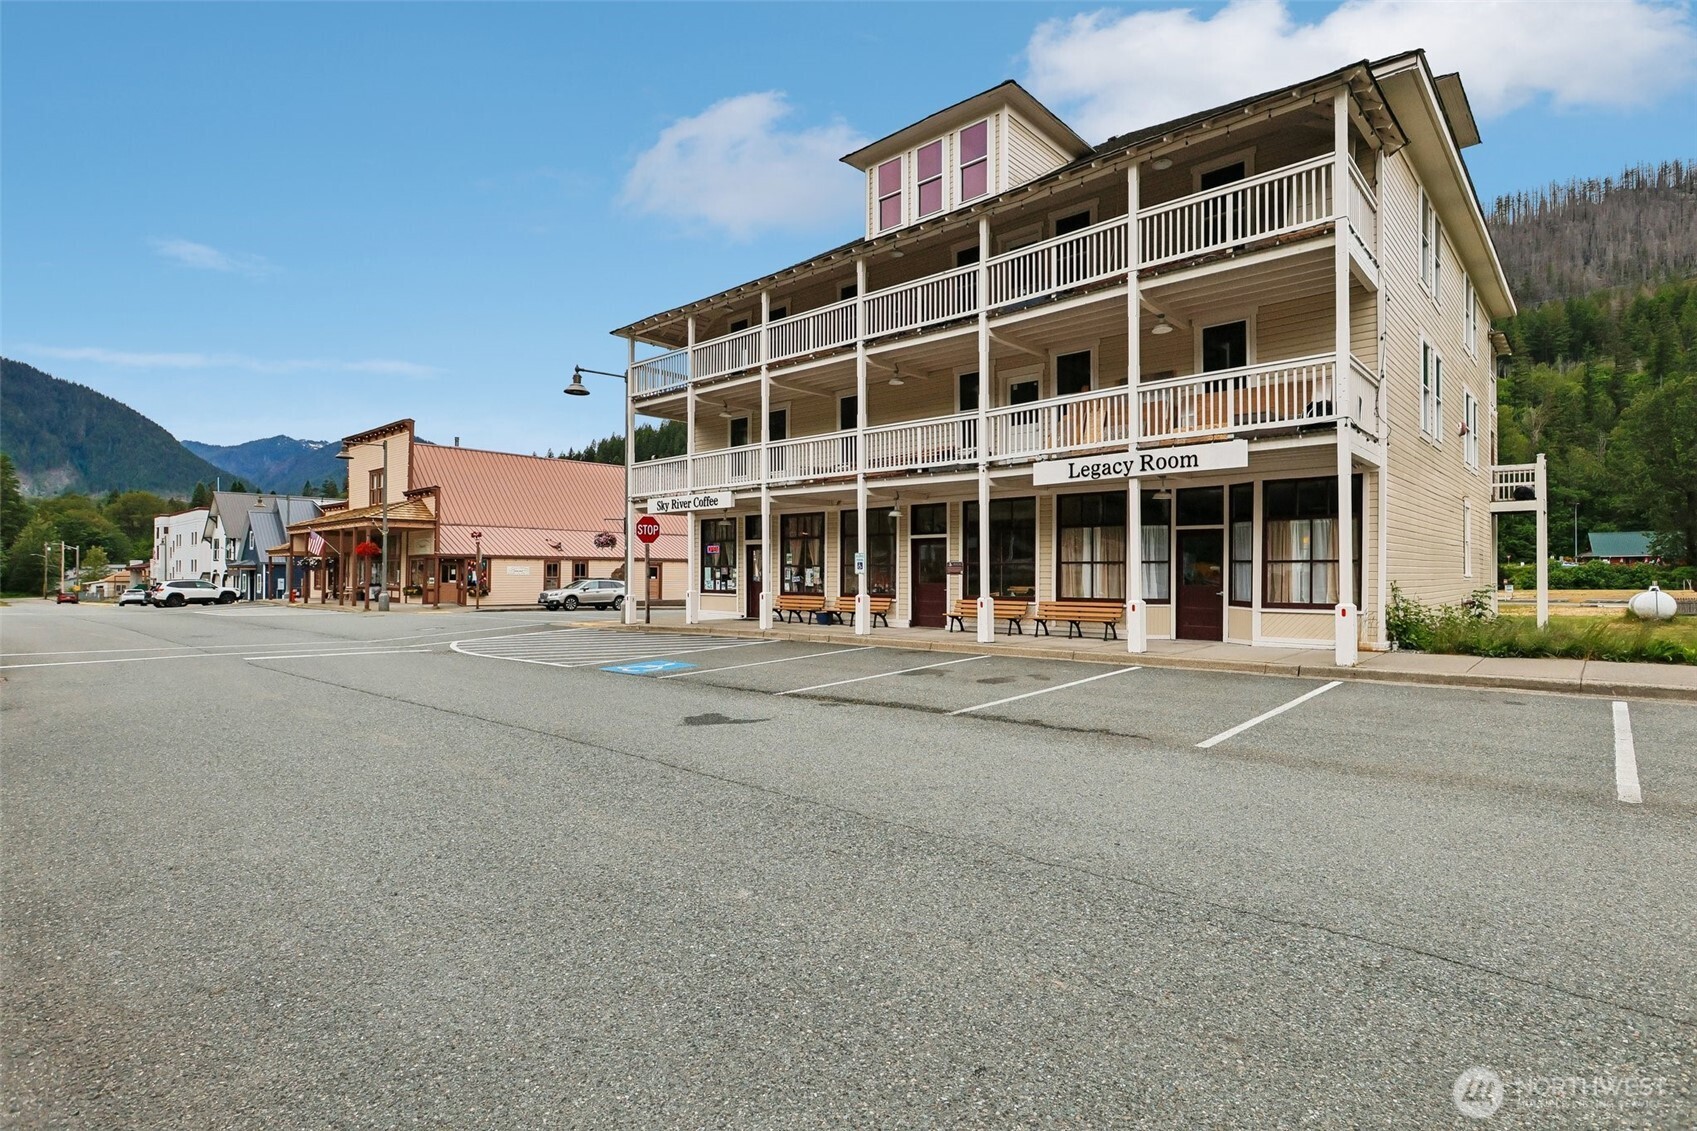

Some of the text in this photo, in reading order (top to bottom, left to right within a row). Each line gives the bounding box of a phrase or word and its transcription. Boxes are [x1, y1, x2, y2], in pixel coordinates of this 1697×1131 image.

[1068, 453, 1199, 479] Legacy Room
[656, 496, 719, 512] Sky River Coffee
[637, 524, 659, 535] STOP
